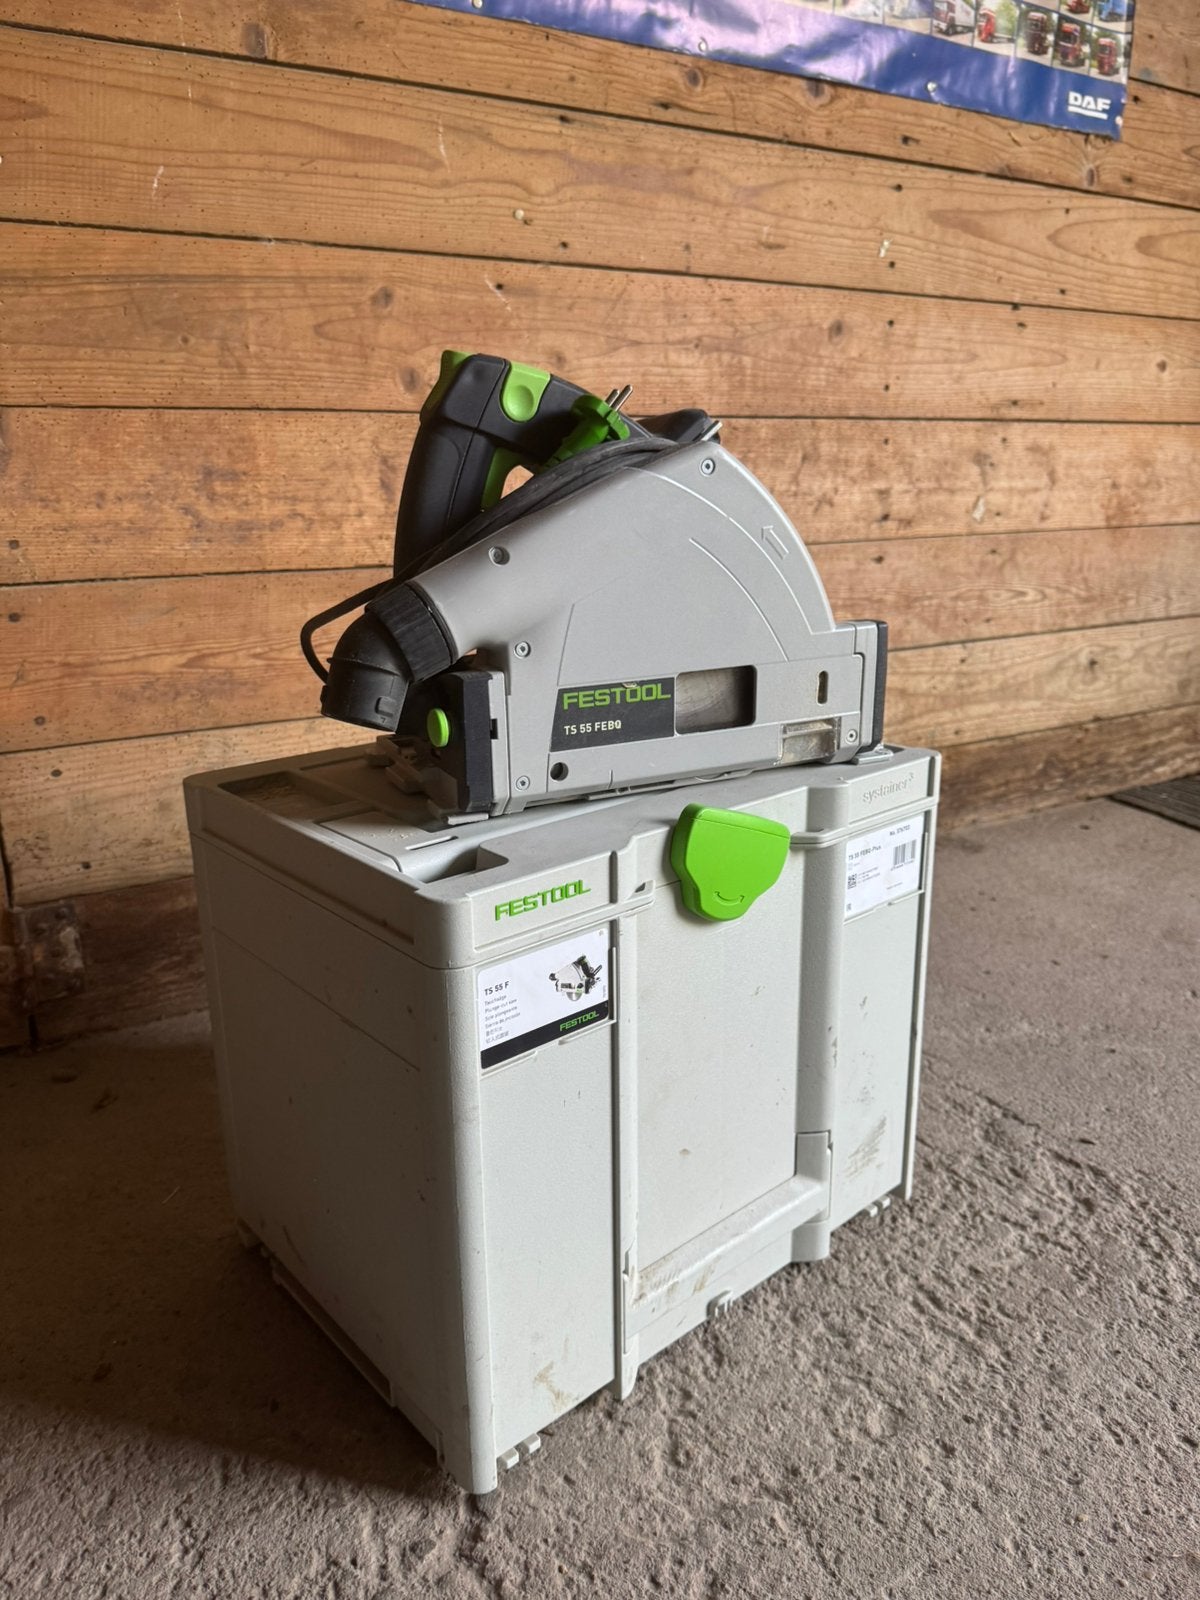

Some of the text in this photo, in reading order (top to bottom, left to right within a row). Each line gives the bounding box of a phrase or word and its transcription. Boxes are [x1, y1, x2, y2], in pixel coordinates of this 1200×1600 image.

[1068, 91, 1112, 111] DAF
[563, 683, 671, 710] FESTOOL
[564, 720, 622, 735] TS 55 FEBQ
[495, 880, 592, 921] FESTOOL
[484, 980, 510, 996] TS 55 F
[560, 1010, 599, 1031] FESTOOL
